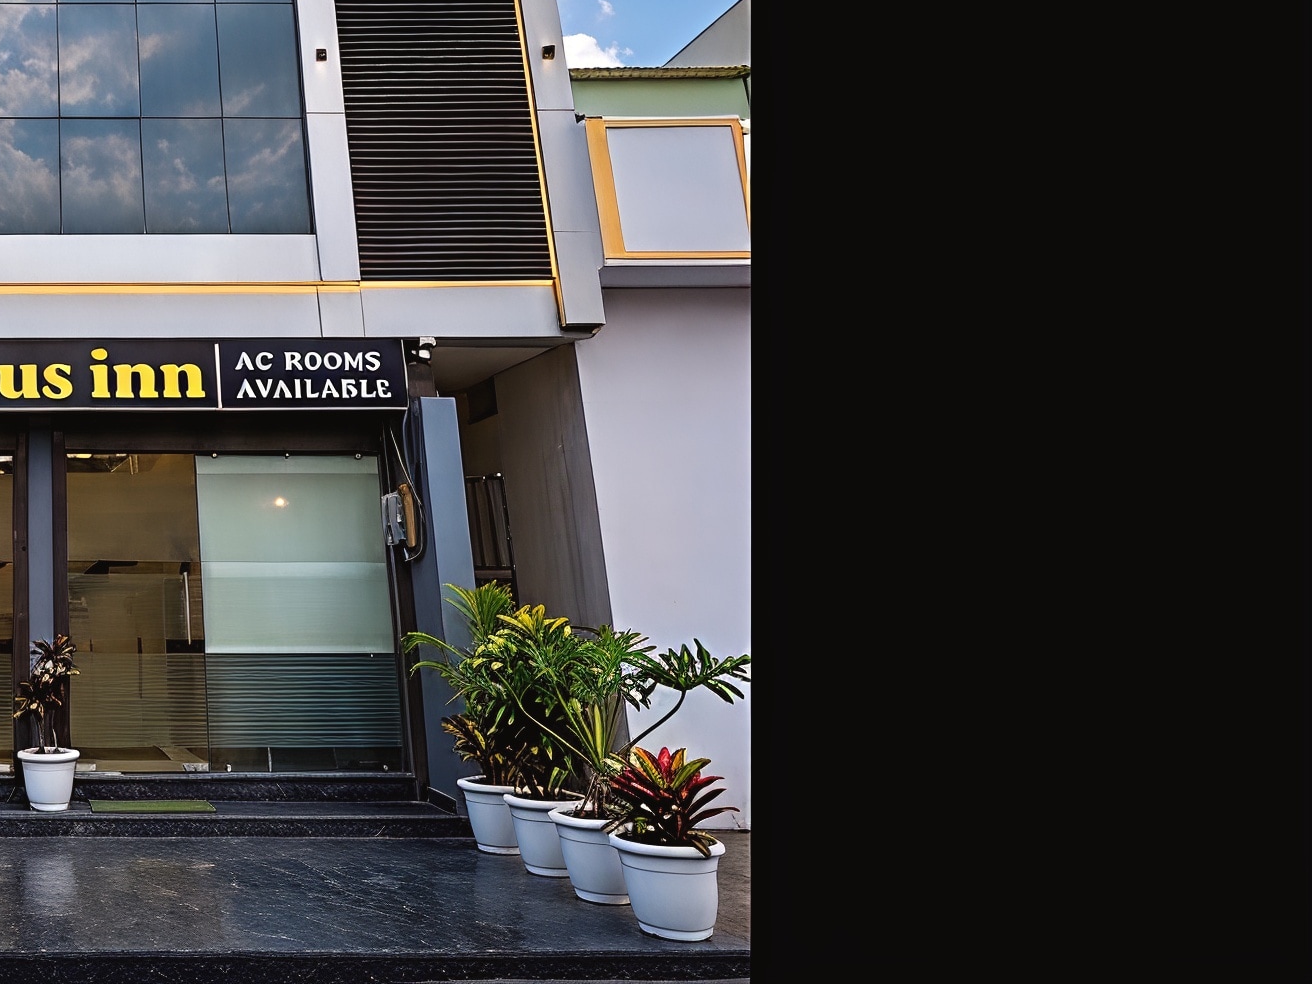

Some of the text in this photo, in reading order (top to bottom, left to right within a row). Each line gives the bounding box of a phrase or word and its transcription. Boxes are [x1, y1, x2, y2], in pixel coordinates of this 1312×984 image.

[235, 351, 381, 372] AC ROOMS
[90, 347, 206, 398] inn
[236, 378, 392, 399] AVAILABLE
